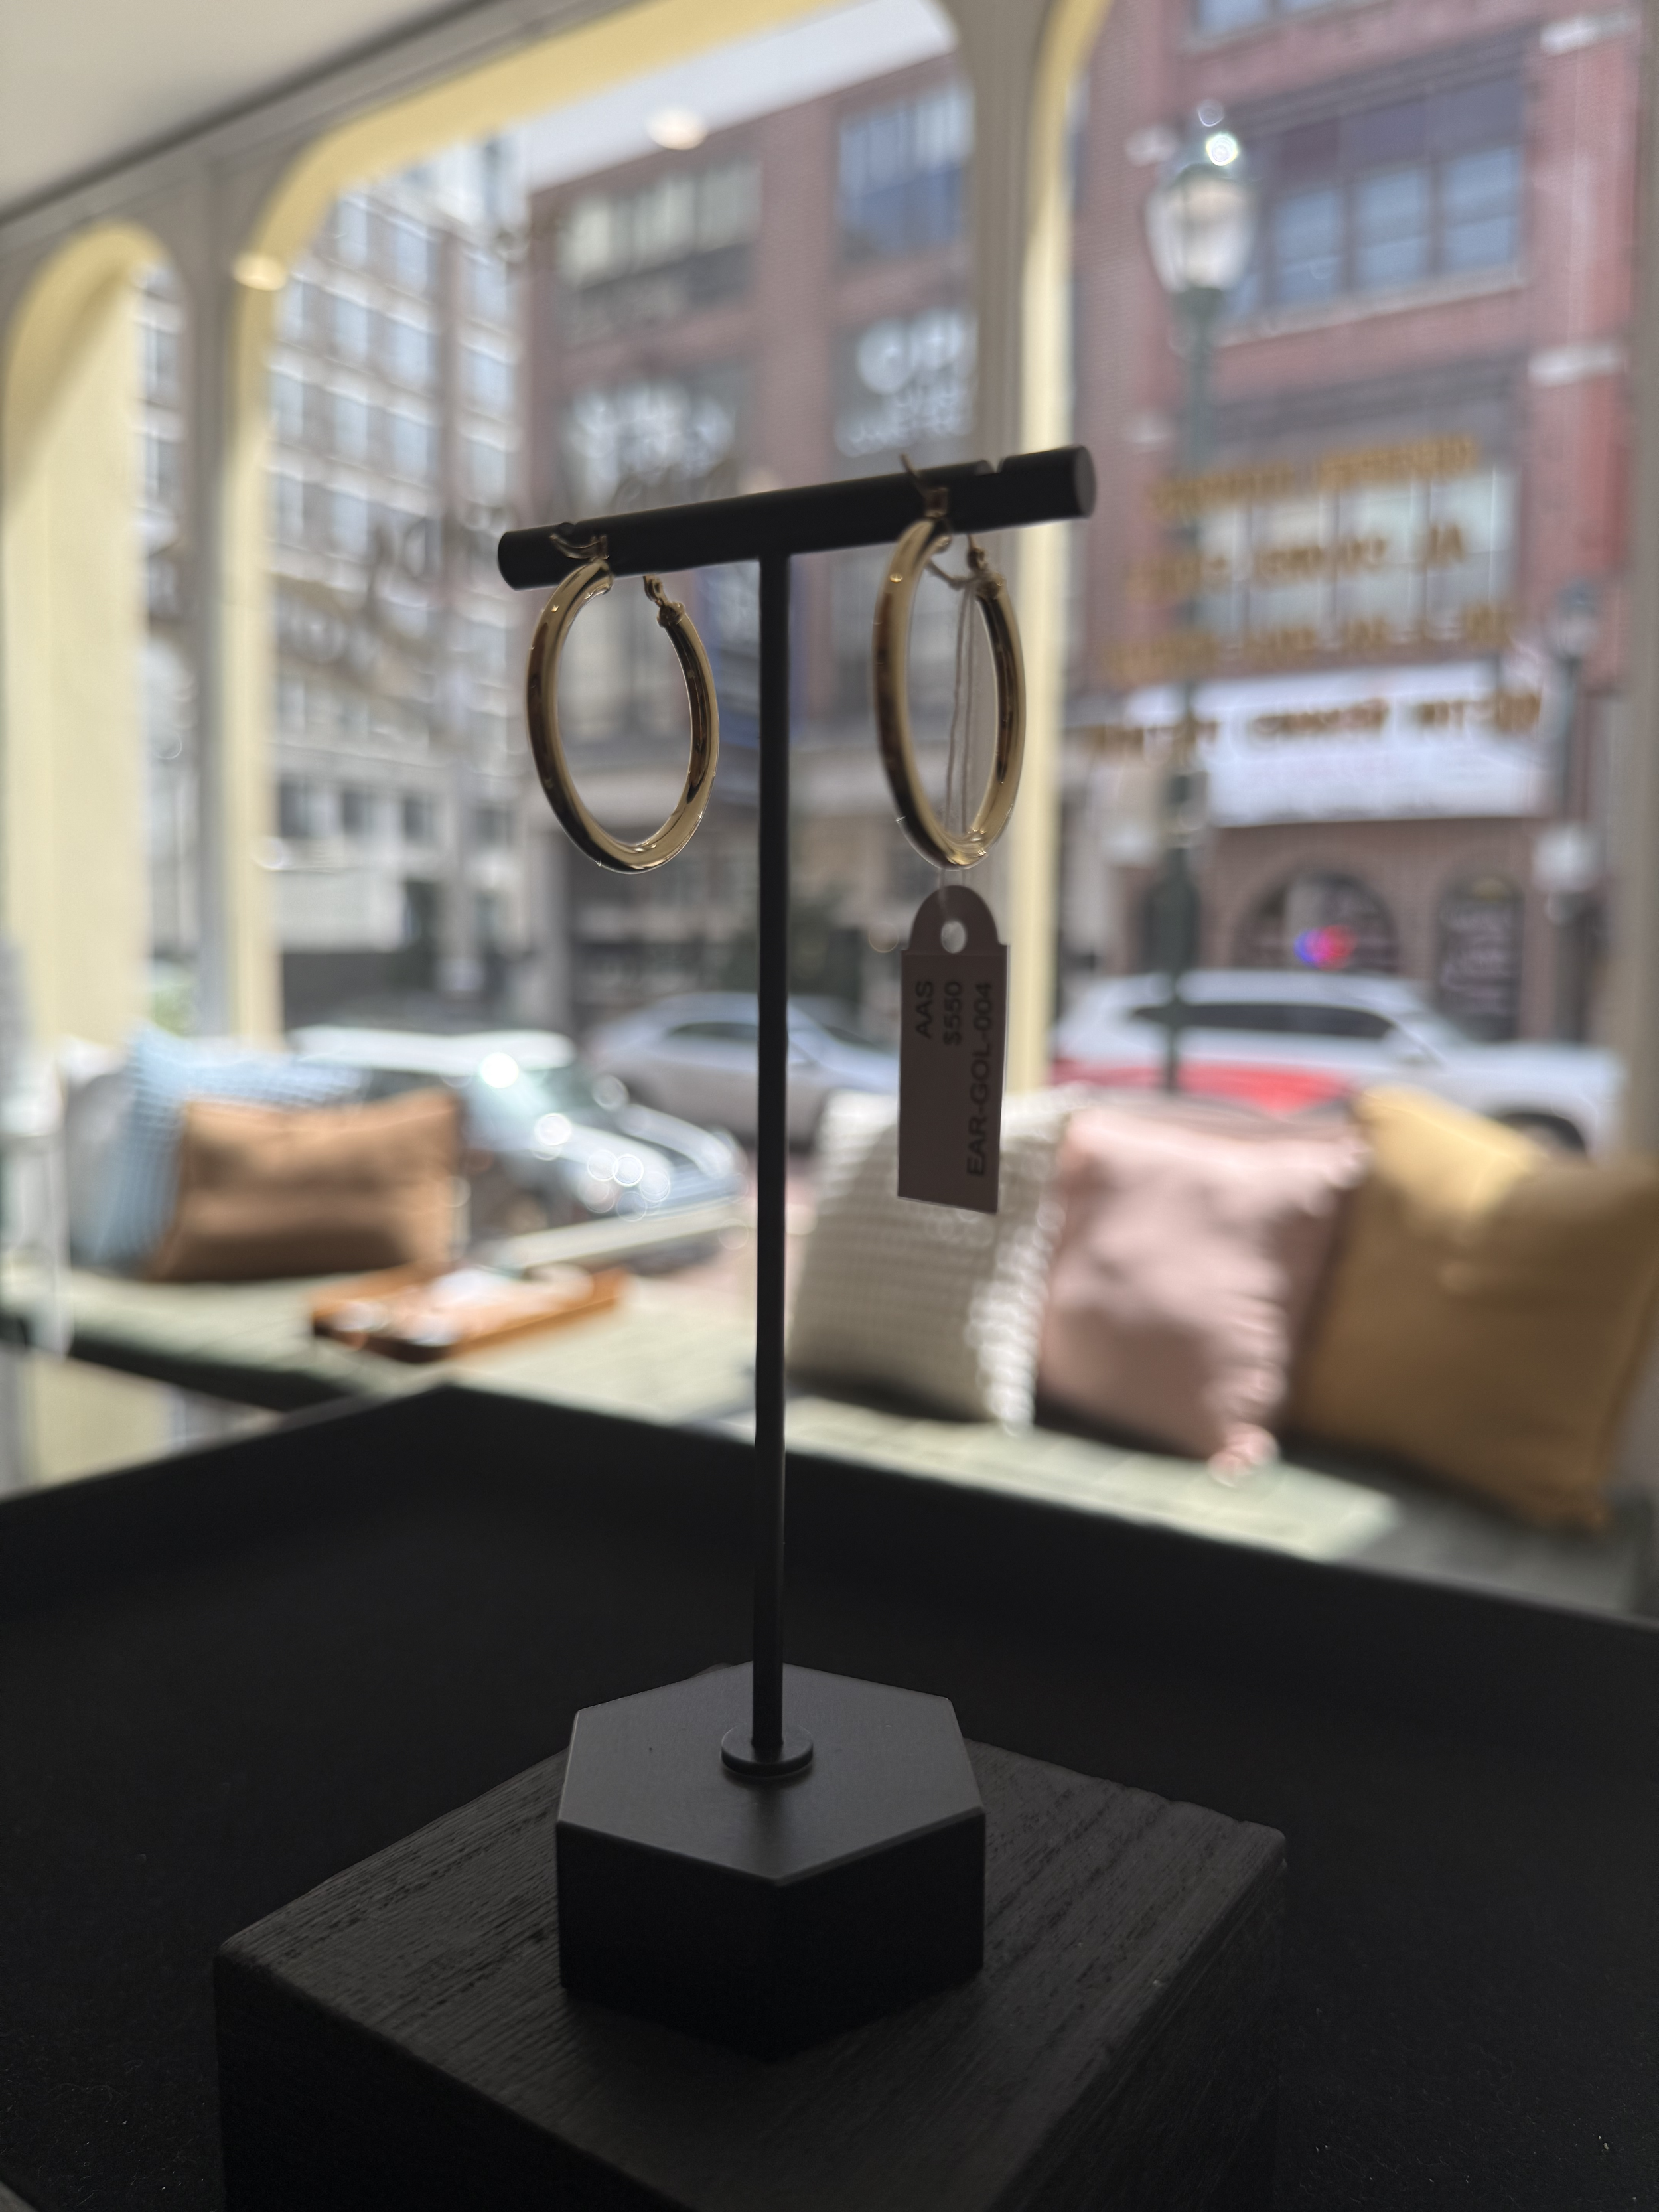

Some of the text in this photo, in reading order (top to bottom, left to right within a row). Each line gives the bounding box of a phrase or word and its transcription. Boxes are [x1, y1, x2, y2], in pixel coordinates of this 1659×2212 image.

[914, 980, 934, 1039] AAS
[943, 980, 962, 1047] $550
[967, 982, 992, 1177] EAR-GOL-004
